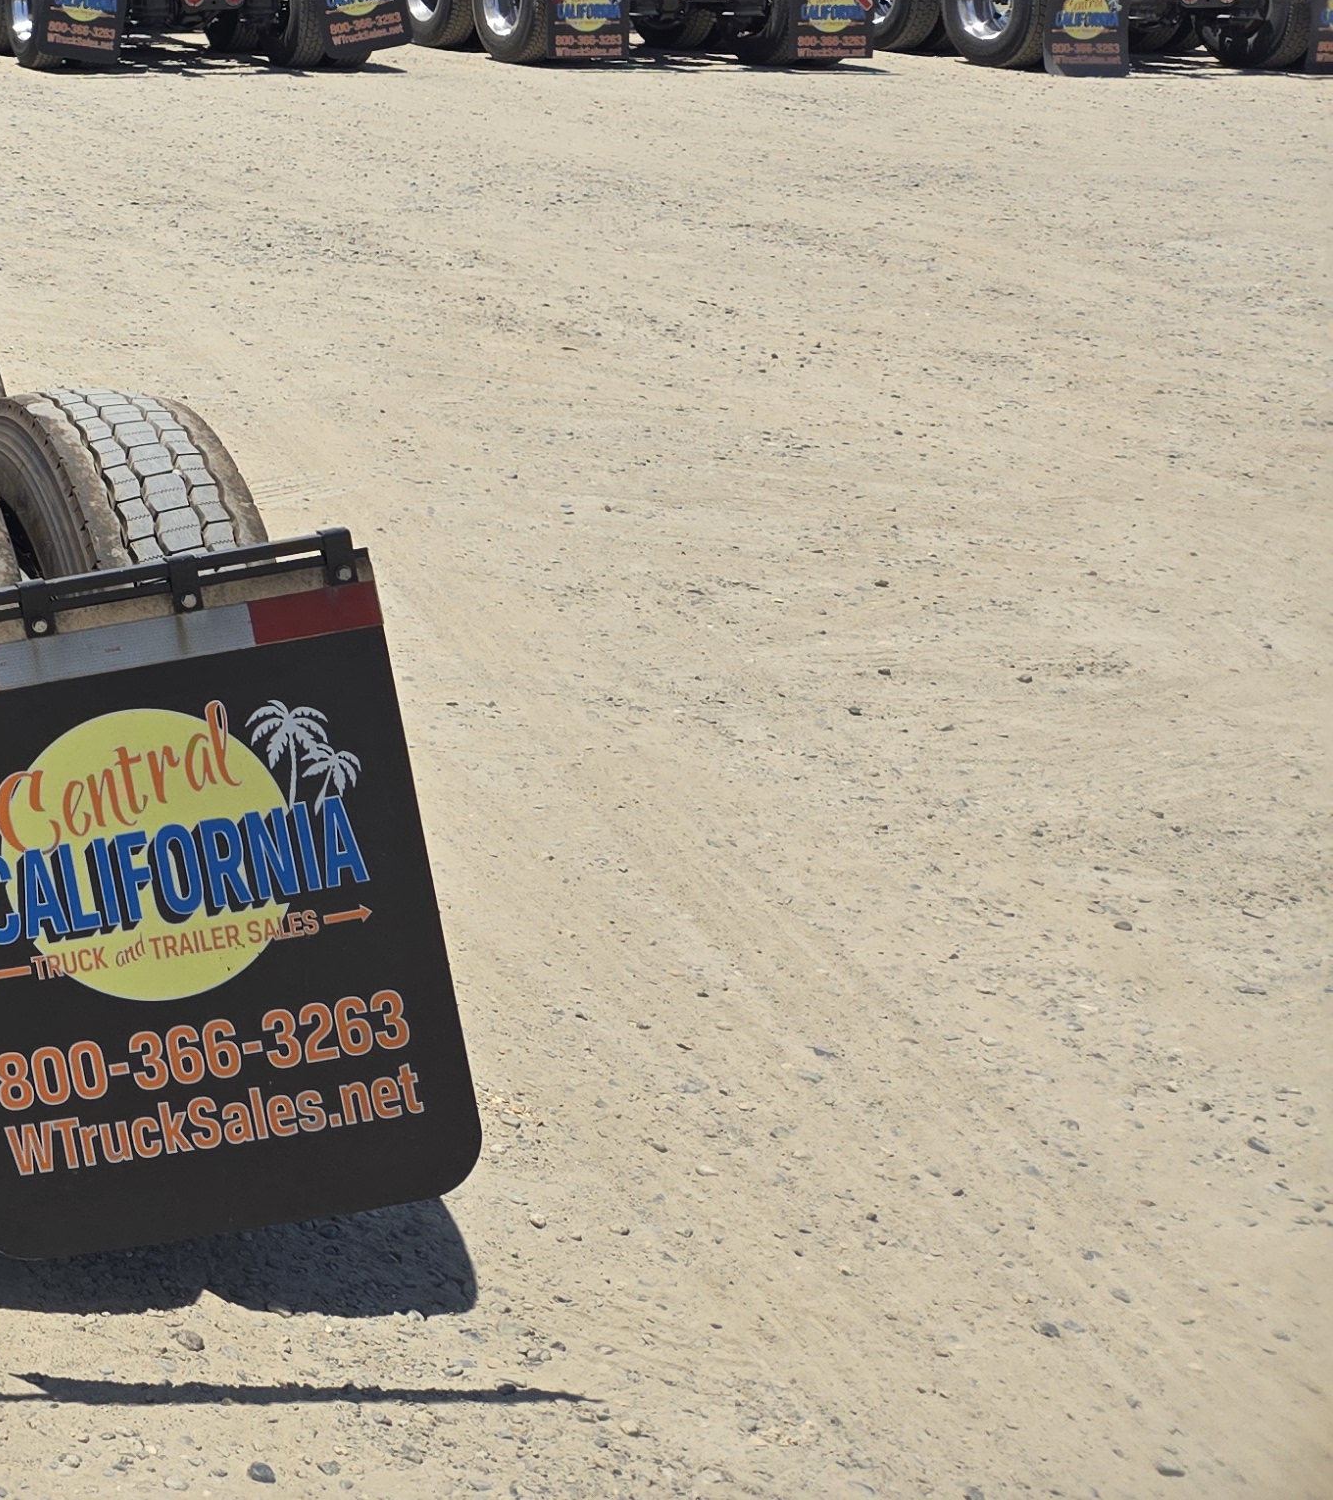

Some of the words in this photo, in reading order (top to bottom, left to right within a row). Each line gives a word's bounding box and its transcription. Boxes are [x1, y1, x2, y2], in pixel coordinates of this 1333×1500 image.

[30, 944, 109, 982] TRUCK
[114, 937, 146, 968] and
[147, 924, 242, 962] TRAILER
[247, 909, 320, 946] SALES
[3, 1062, 424, 1177] WTruckSales.net
